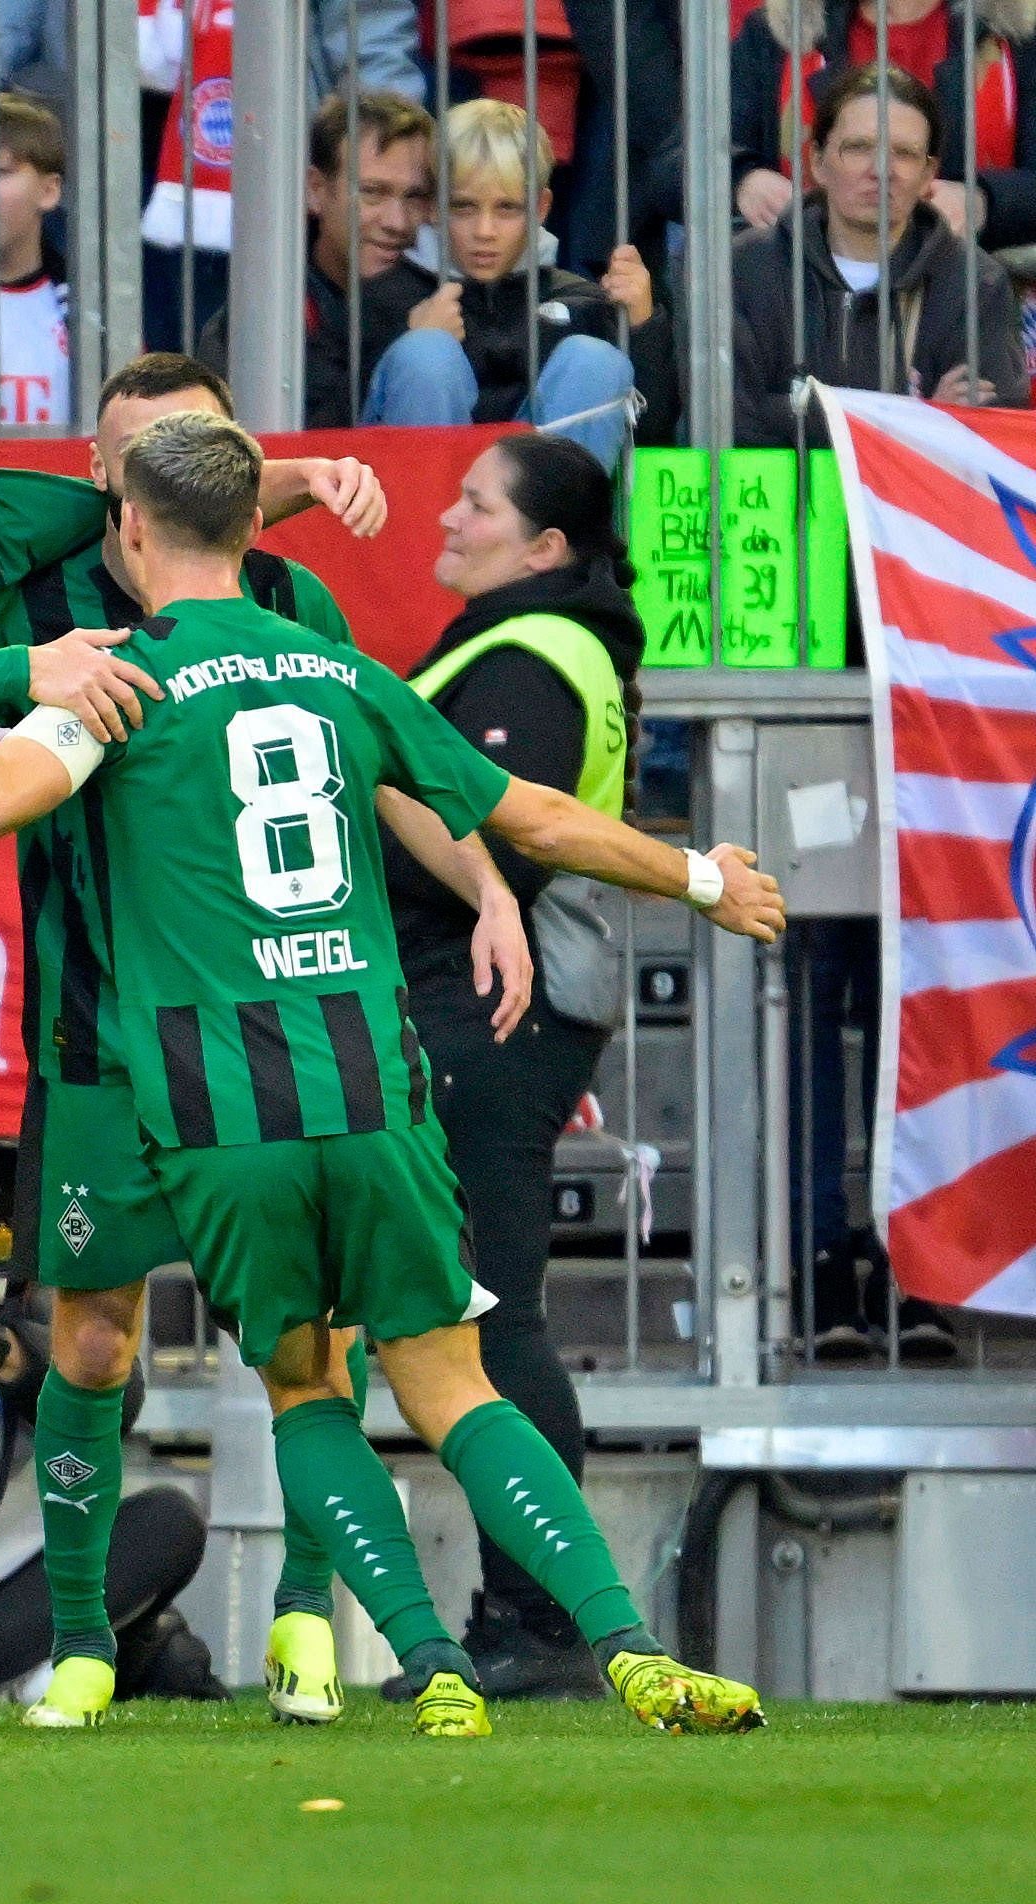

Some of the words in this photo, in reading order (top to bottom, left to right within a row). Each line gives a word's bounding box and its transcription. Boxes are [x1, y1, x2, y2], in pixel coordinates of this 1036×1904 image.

[658, 469, 720, 508] Dar
[743, 564, 777, 610] 39
[660, 608, 772, 659] Mthys
[226, 703, 353, 918] 8
[252, 929, 368, 980] WEIGL
[436, 1682, 458, 1691] KING
